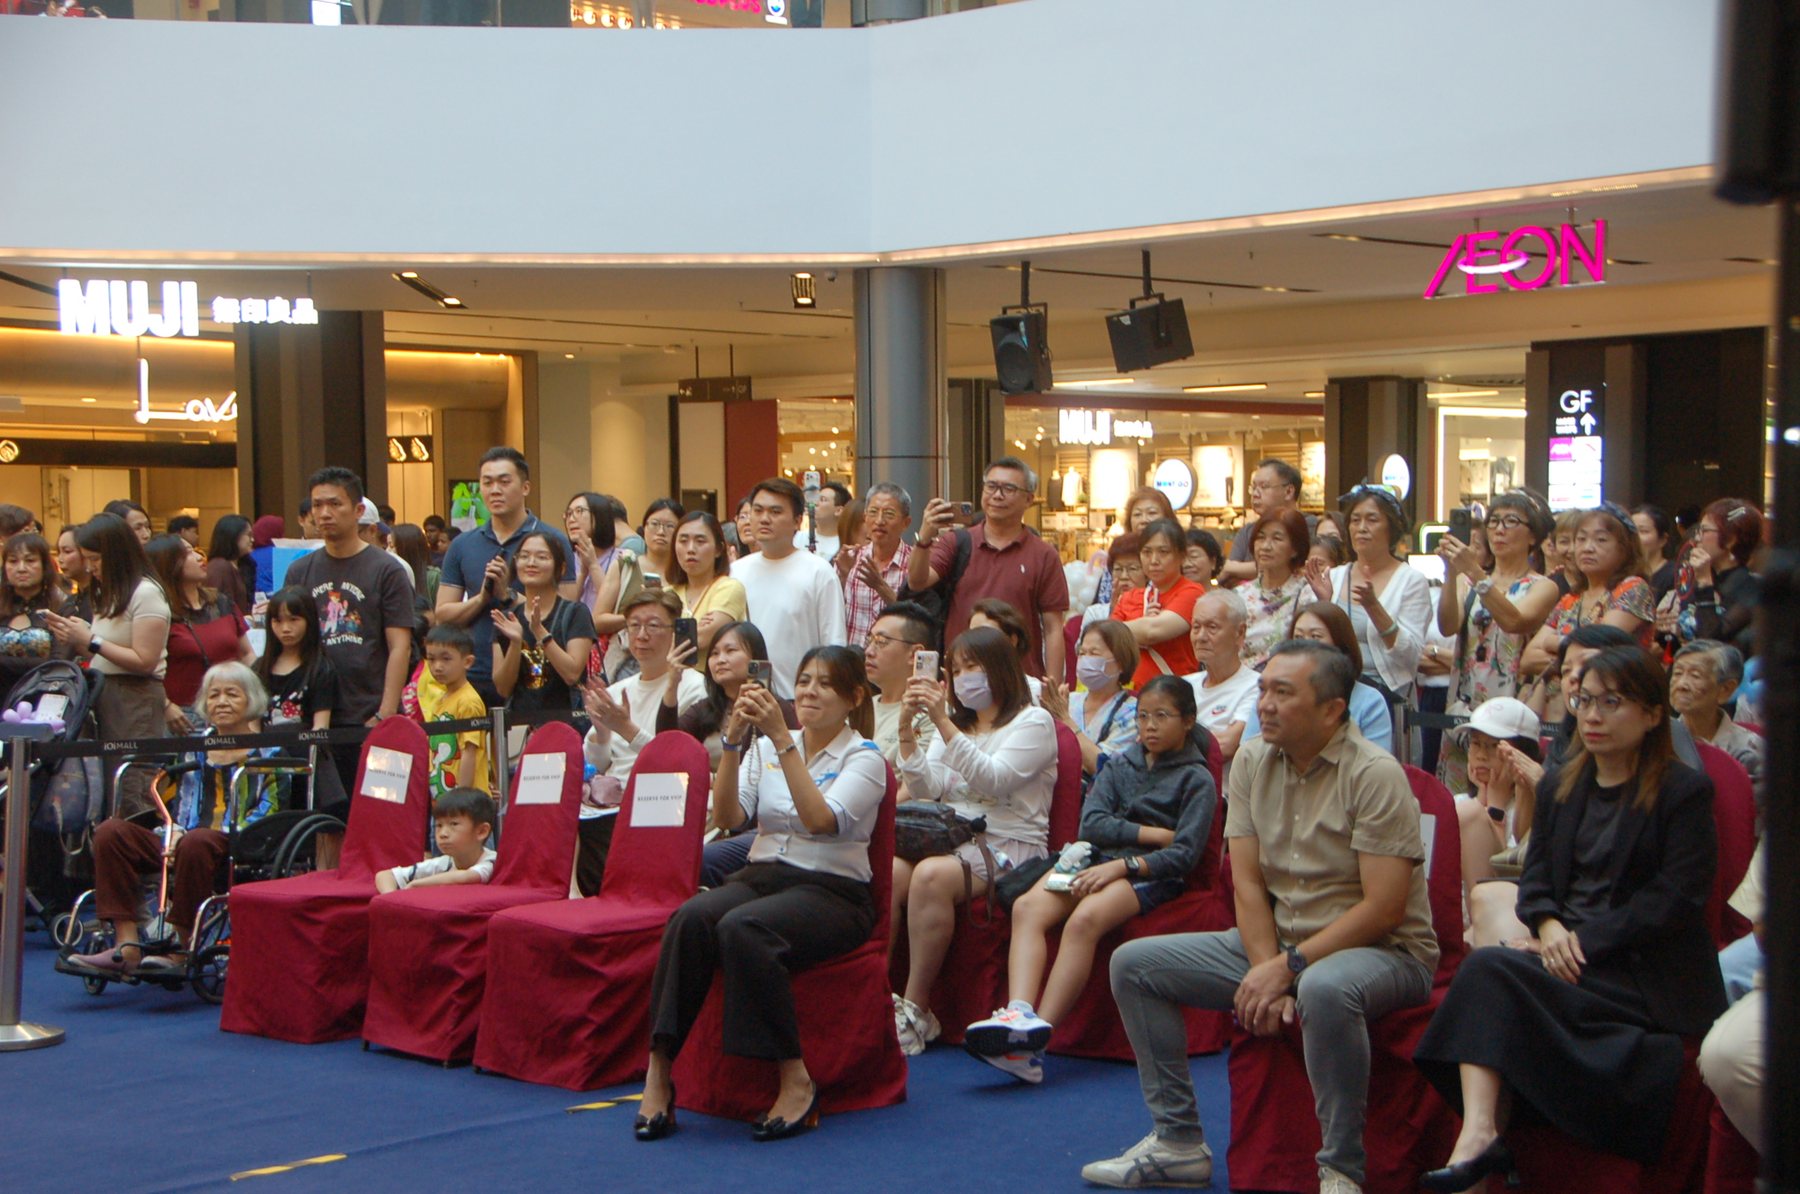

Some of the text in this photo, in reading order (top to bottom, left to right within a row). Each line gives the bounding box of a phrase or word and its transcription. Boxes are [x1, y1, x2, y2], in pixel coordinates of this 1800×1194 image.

[58, 279, 199, 337] MUJI
[1560, 389, 1593, 413] GF
[1058, 409, 1111, 445] MUJI
[326, 634, 363, 646] ANYTHING
